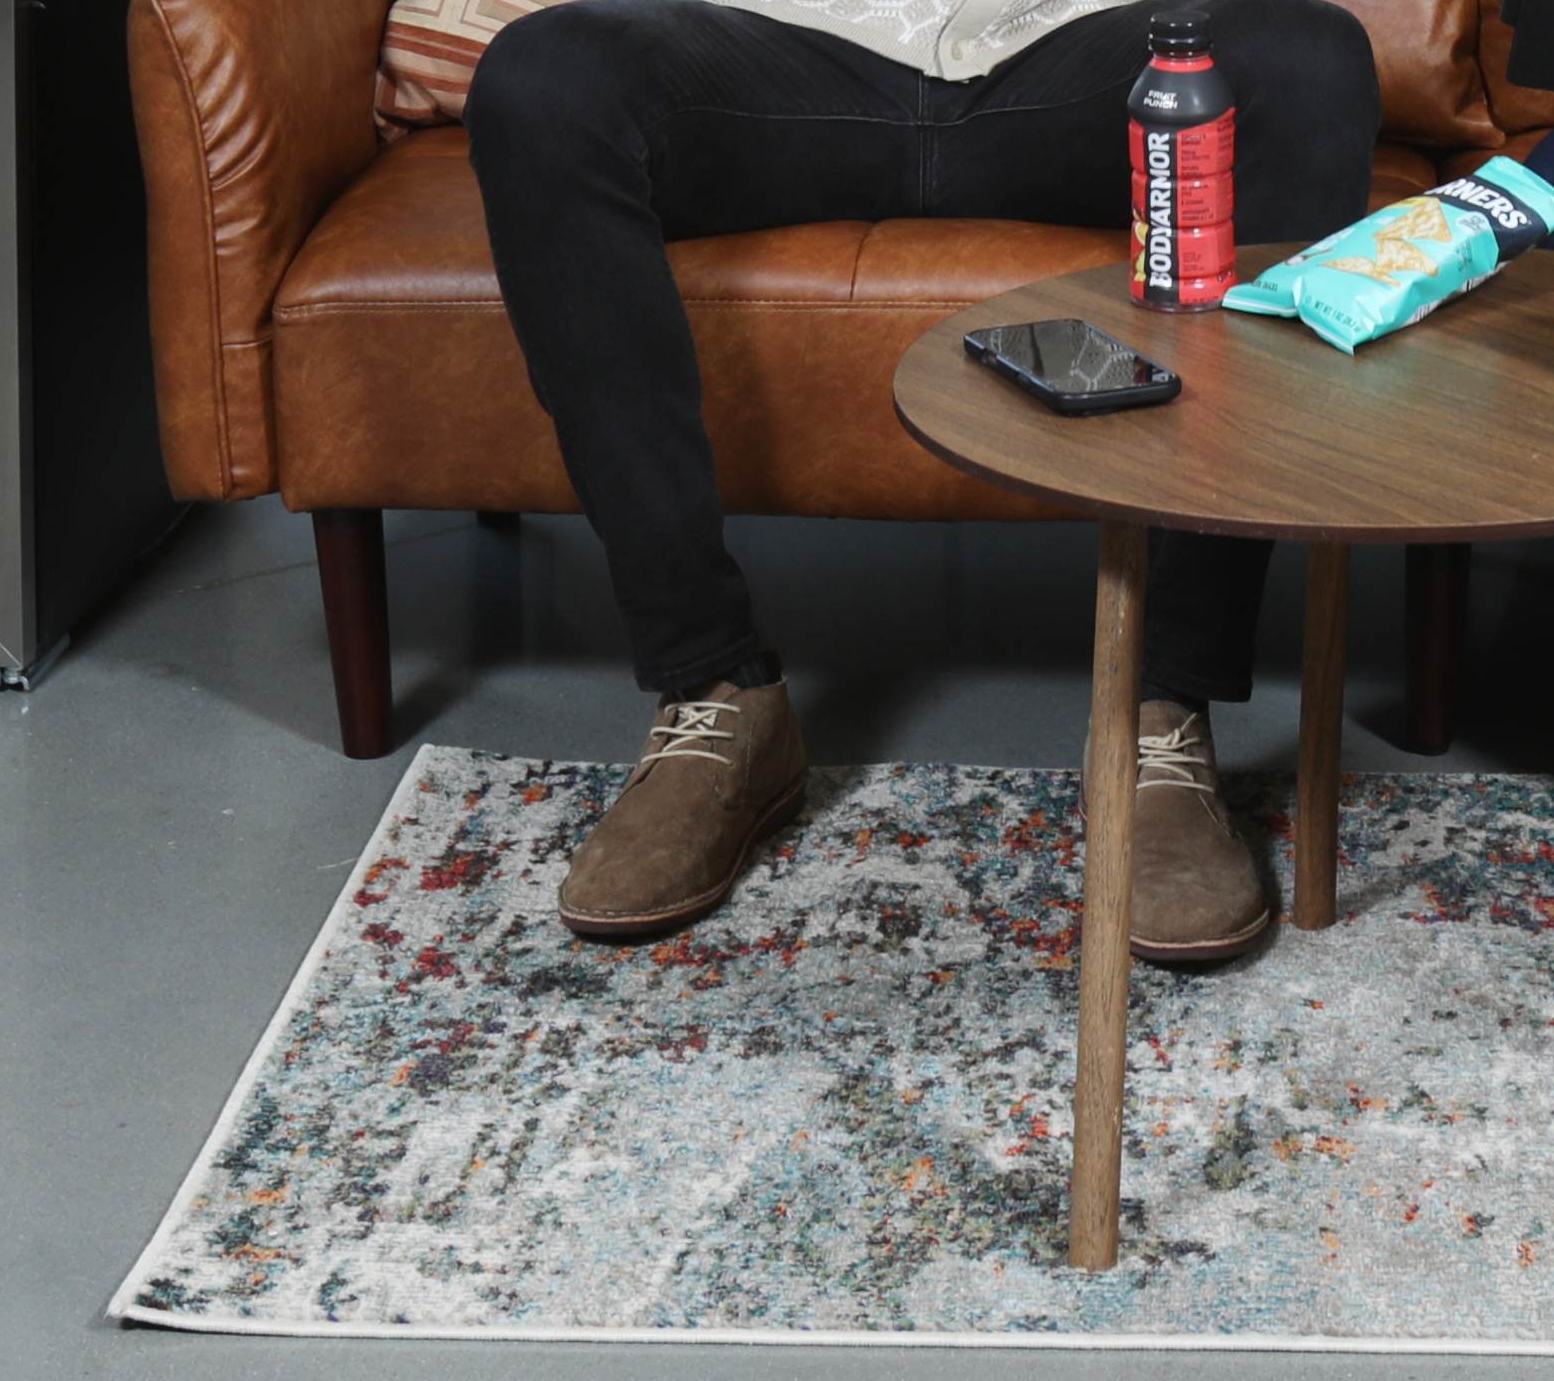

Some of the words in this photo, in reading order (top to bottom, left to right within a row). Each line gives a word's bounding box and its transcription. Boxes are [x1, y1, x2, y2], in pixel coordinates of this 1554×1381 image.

[1148, 89, 1177, 100] FRUIT
[1143, 97, 1178, 109] PUNCH
[1147, 132, 1173, 288] BODYARMOR
